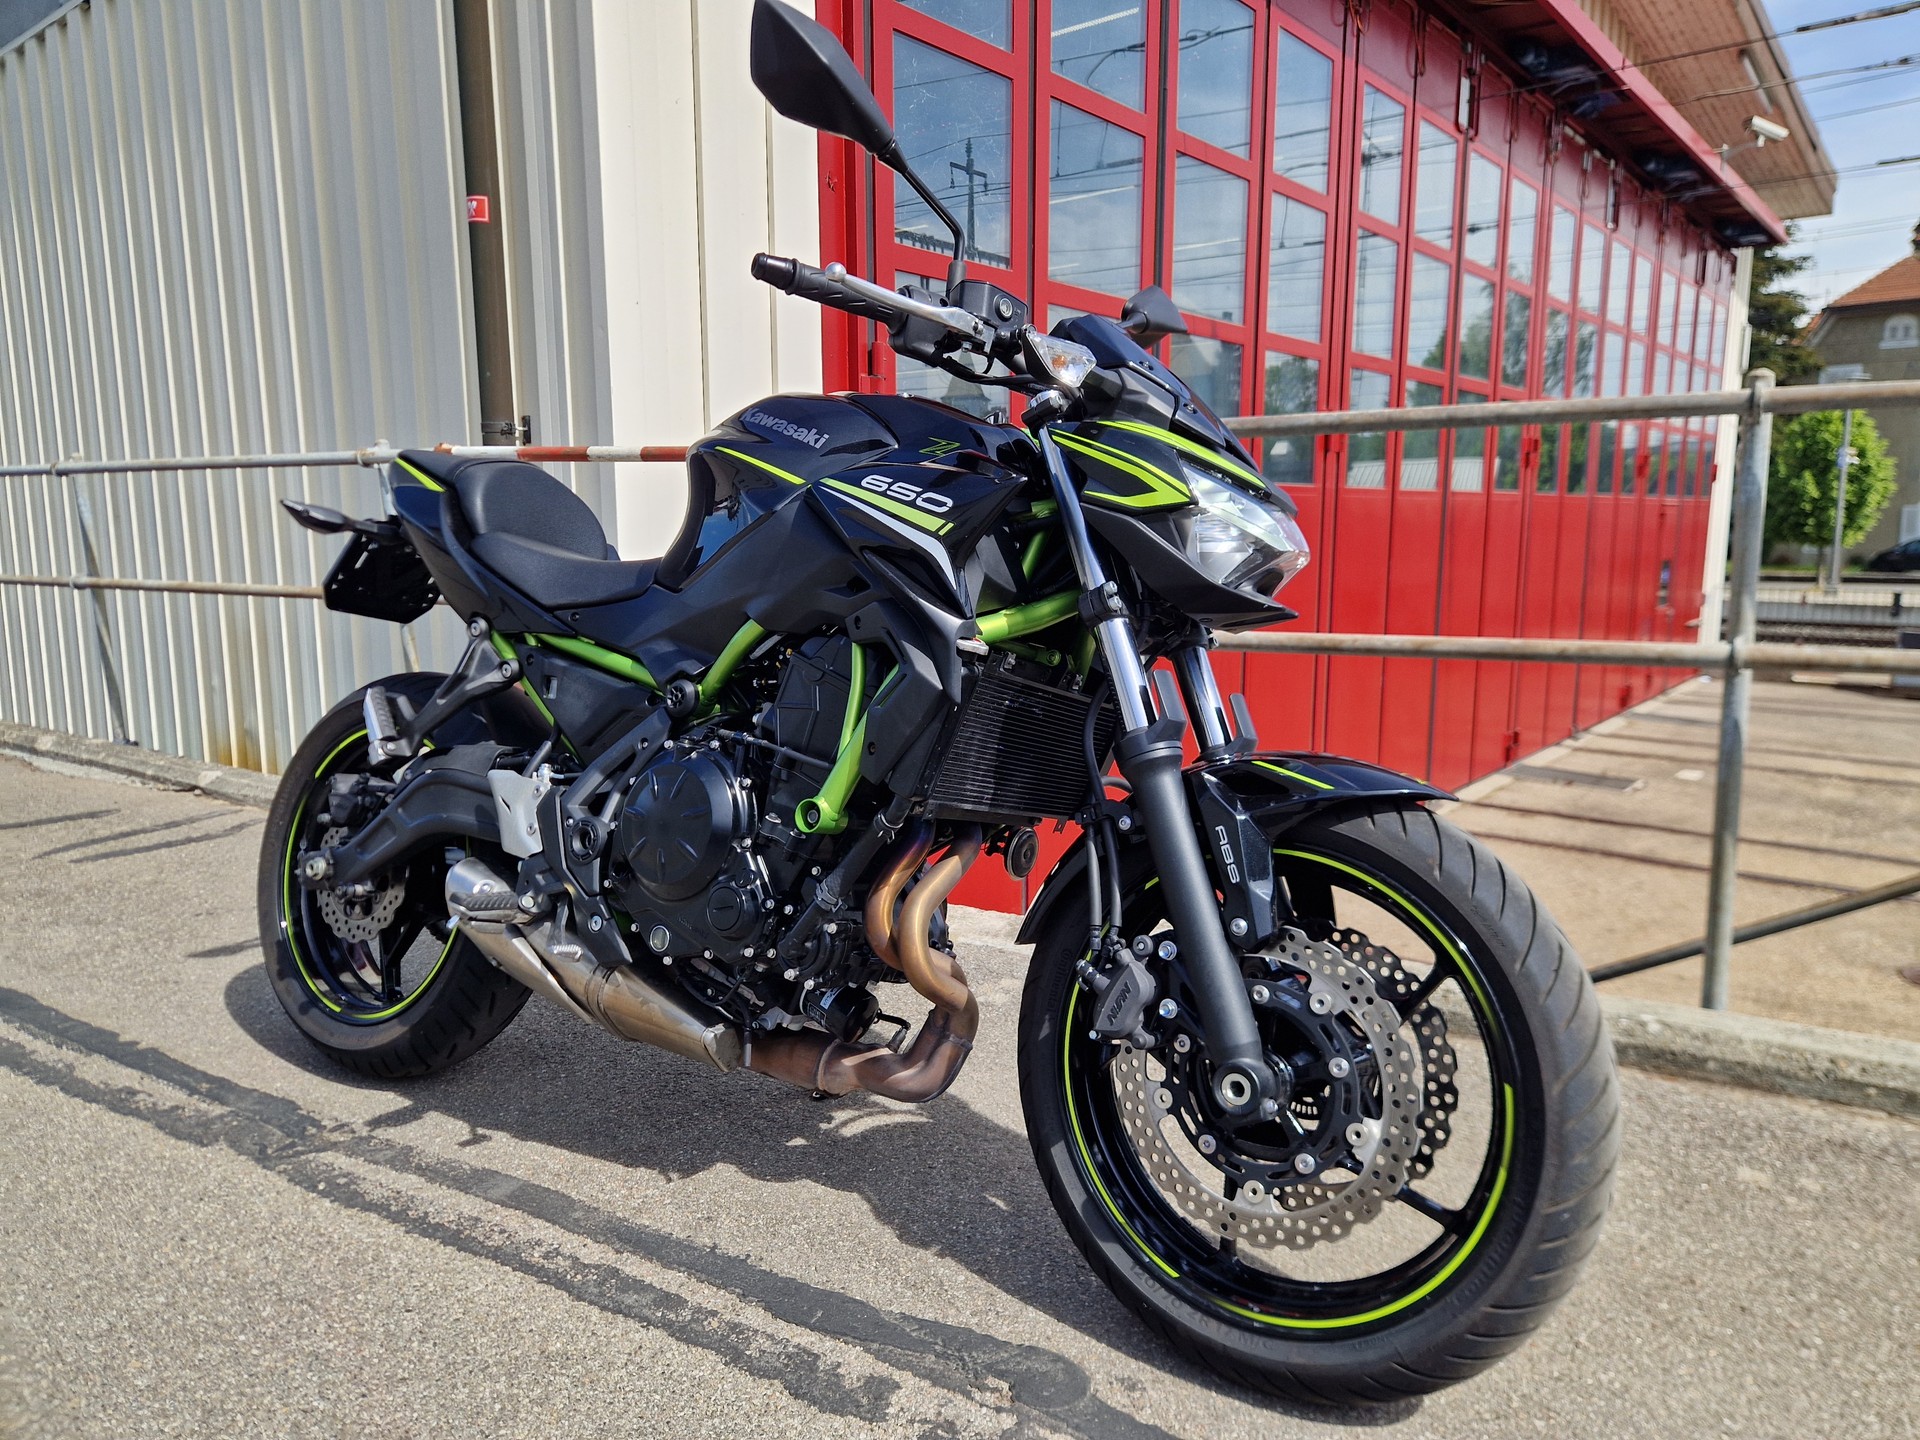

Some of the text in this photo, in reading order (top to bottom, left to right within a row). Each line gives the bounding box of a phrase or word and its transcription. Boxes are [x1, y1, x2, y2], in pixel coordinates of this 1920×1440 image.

[741, 408, 829, 449] Kawasaki
[919, 437, 961, 456] Z
[861, 475, 952, 513] 650
[1215, 825, 1240, 882] ABS
